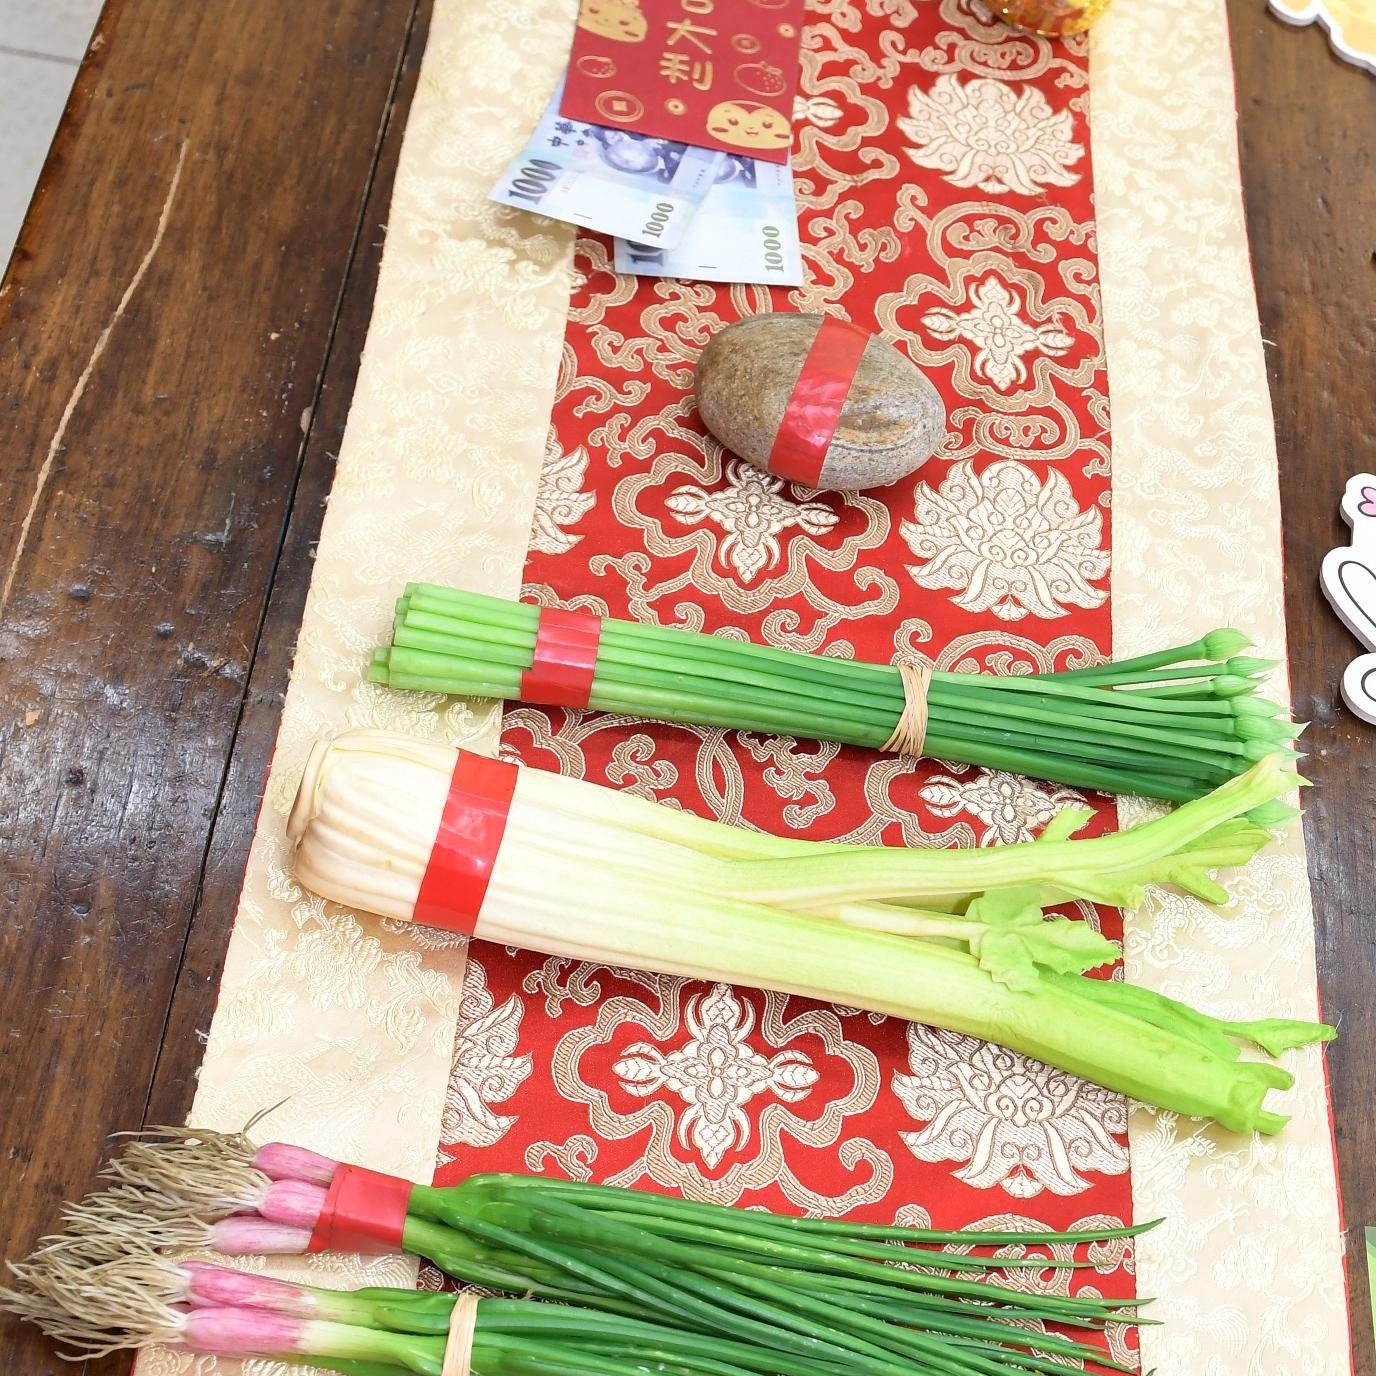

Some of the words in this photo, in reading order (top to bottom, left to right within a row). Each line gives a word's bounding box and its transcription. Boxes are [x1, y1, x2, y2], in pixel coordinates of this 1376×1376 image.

[508, 159, 563, 205] 1000
[642, 202, 674, 238] 1000
[762, 225, 784, 273] 1000
